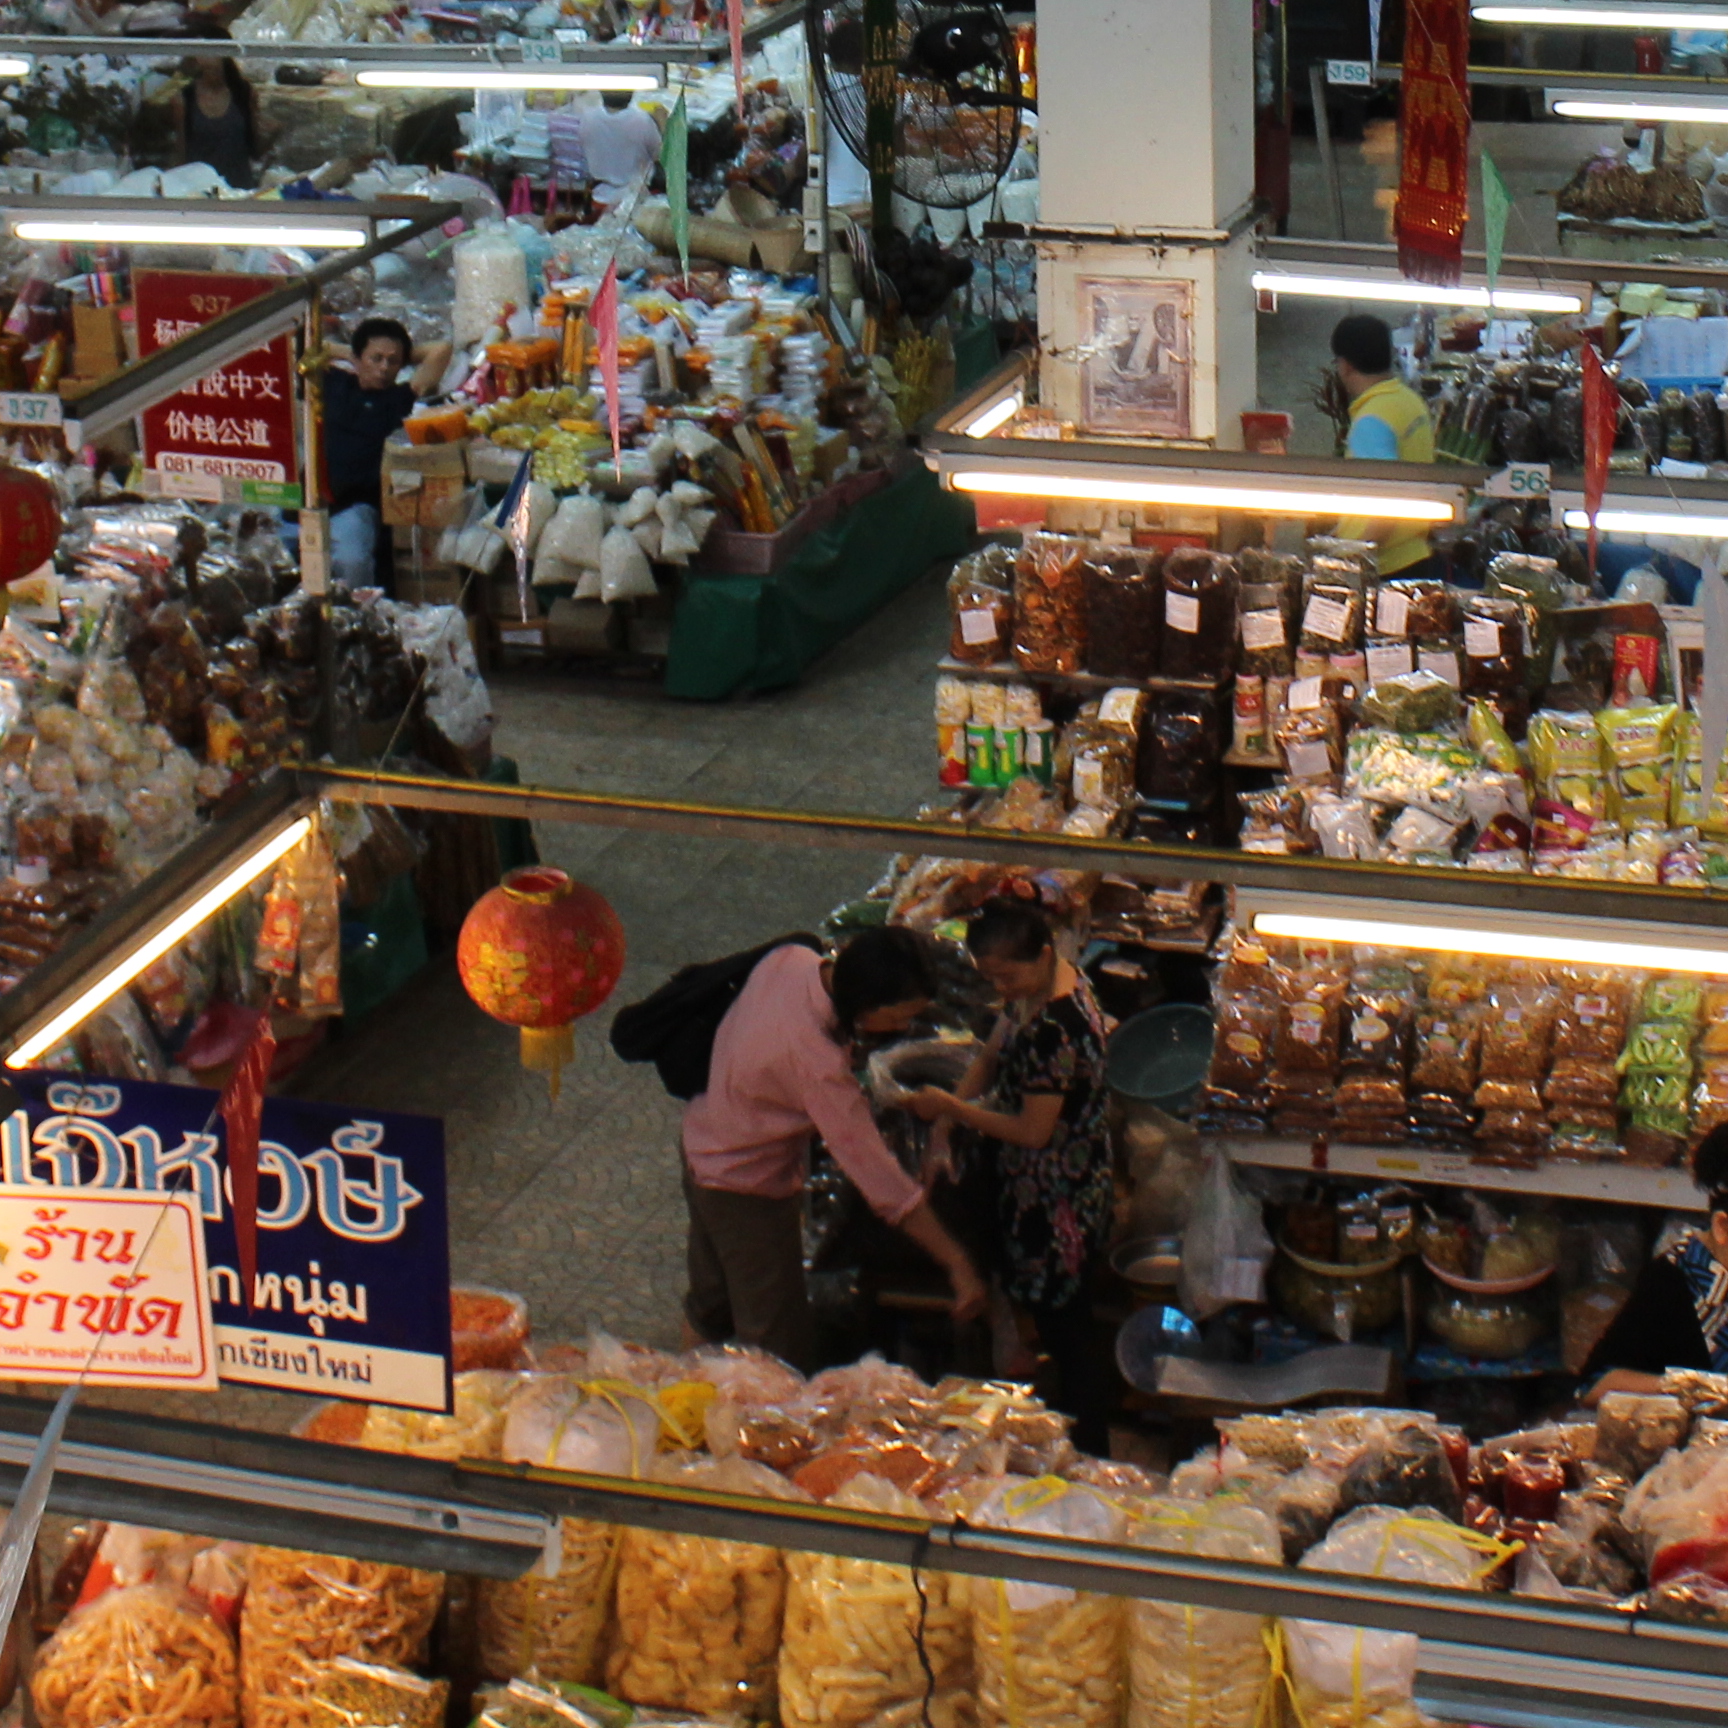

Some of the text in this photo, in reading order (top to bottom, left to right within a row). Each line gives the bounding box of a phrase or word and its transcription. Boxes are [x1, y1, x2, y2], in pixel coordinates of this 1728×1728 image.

[1510, 470, 1545, 491] 56
[23, 1206, 137, 1265] ร้าน
[216, 1336, 373, 1384] กเชียงใหม่
